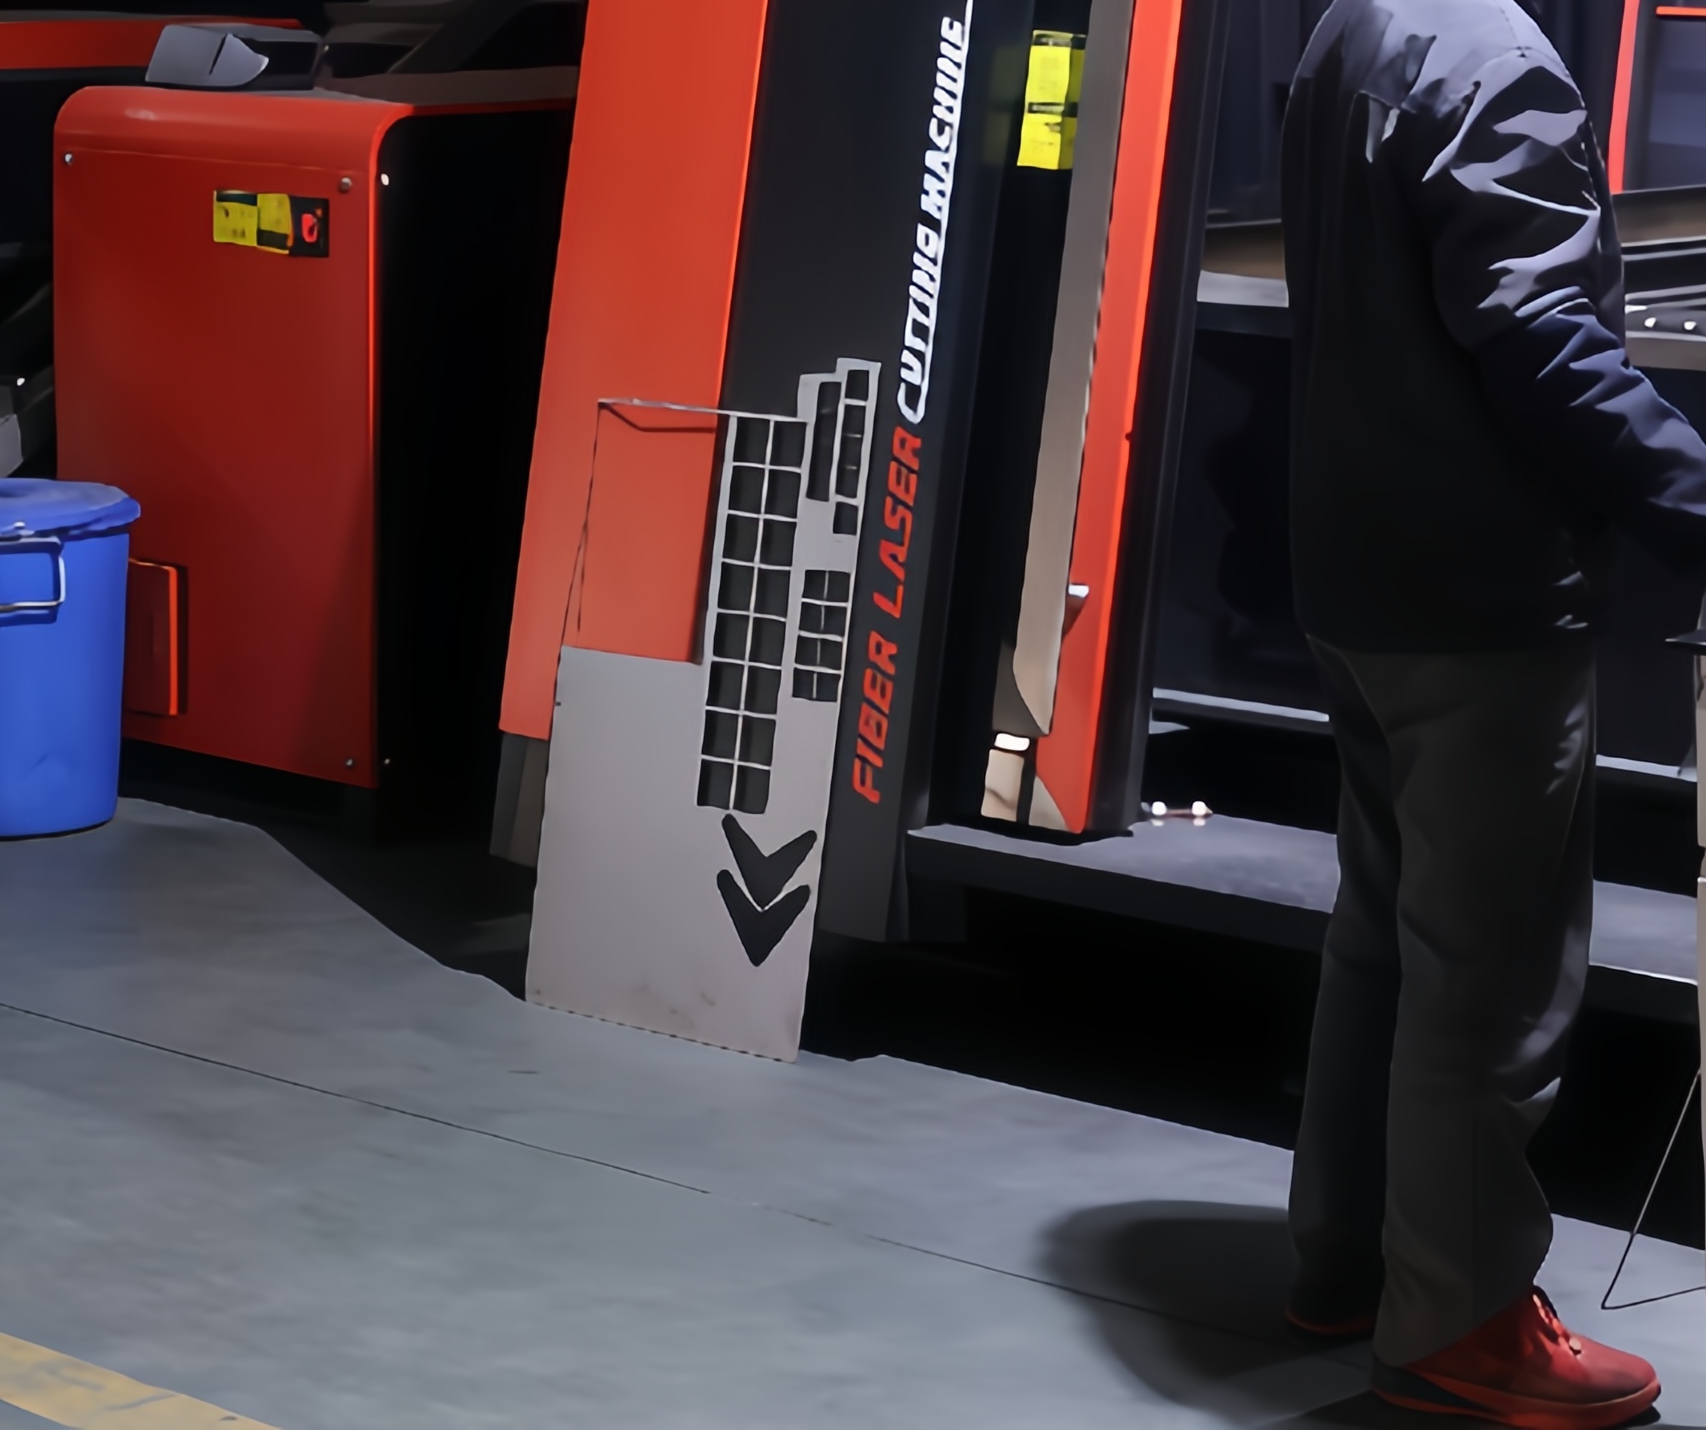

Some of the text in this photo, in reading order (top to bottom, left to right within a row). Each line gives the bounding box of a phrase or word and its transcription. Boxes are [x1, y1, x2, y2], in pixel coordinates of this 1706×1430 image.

[851, 15, 967, 805] FIBER LASER CUTTING MACHINE
